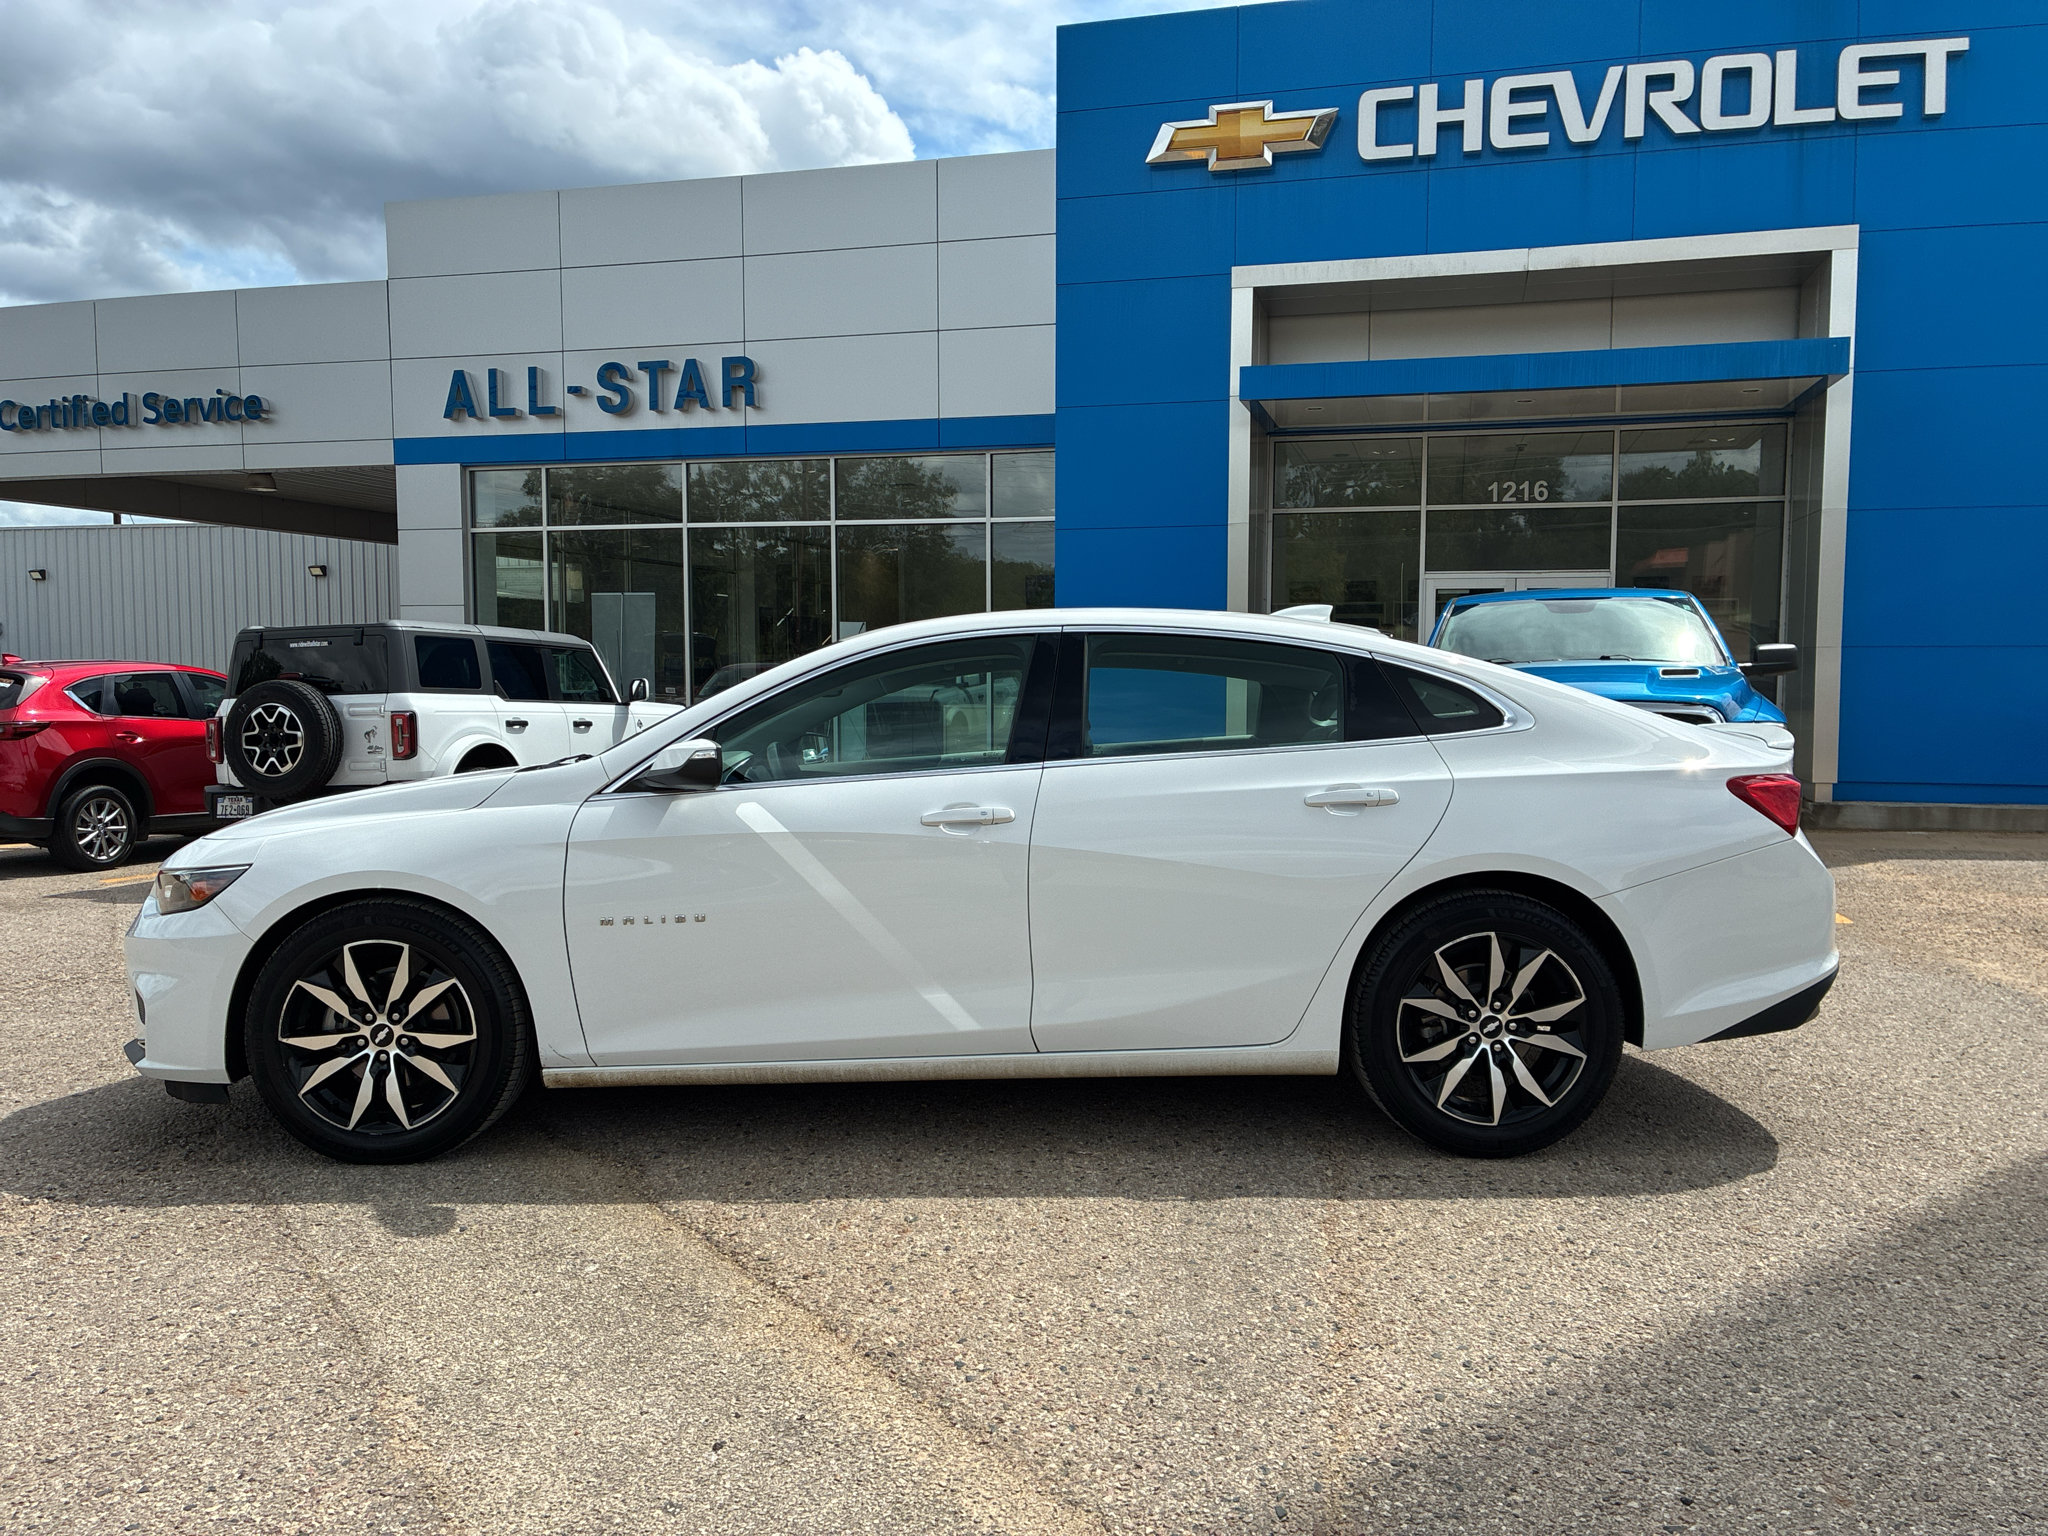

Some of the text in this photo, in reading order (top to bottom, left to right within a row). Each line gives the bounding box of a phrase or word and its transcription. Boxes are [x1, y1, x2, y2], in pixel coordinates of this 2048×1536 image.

[1358, 37, 1970, 162] CHEVROLET
[0, 388, 265, 431] Certified Service
[443, 356, 759, 420] ALL-STAR
[1488, 480, 1549, 502] 1216
[600, 914, 706, 926] MALIBU
